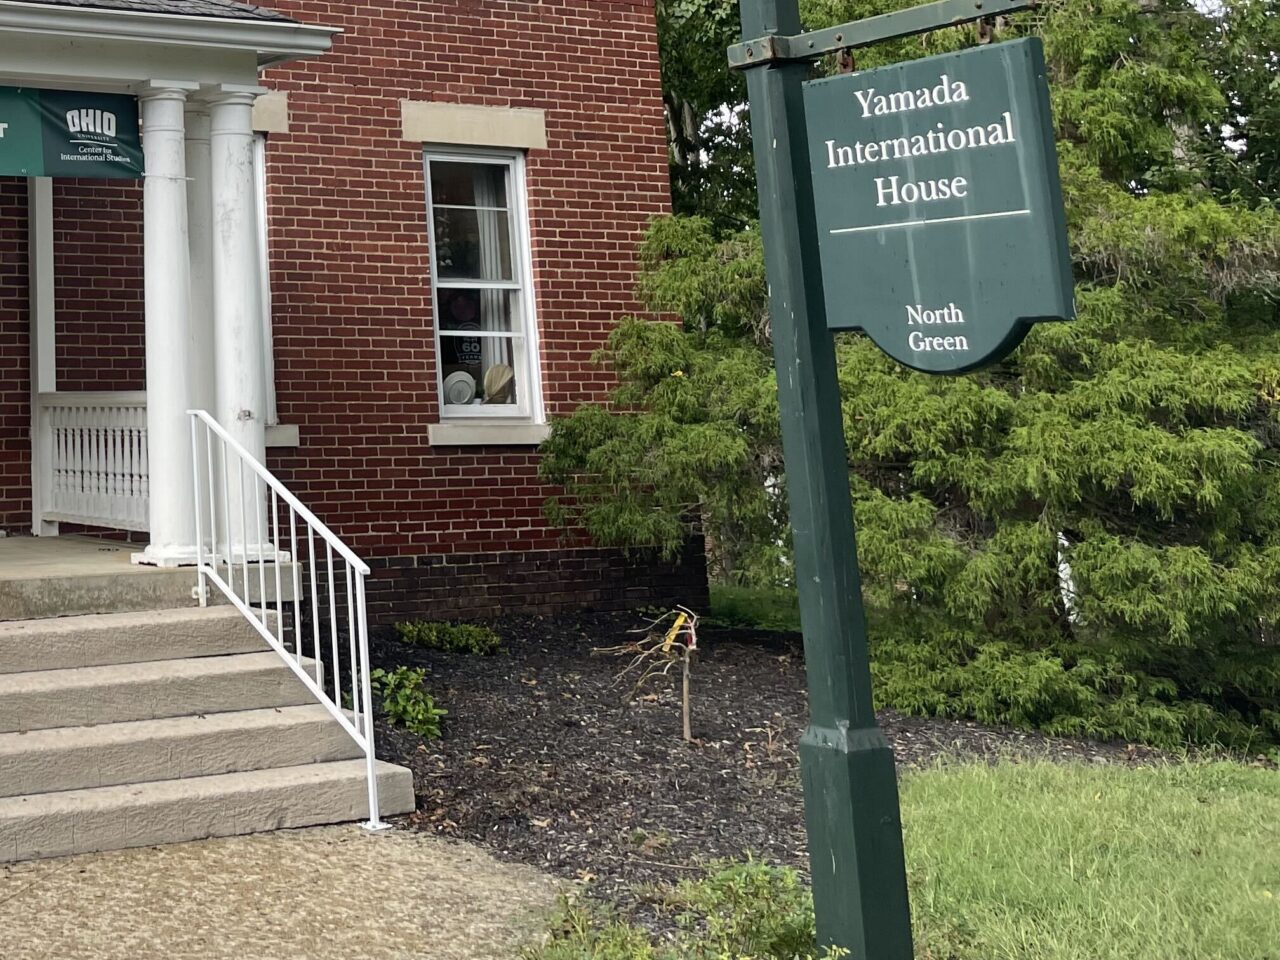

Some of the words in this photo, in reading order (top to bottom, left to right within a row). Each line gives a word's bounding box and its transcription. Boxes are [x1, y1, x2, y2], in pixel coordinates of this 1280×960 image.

[854, 74, 969, 118] Yamada
[66, 108, 116, 137] OHIO
[825, 112, 1016, 168] International
[60, 153, 105, 161] International
[874, 175, 968, 207] House
[905, 302, 965, 325] North
[462, 342, 480, 352] 60
[908, 331, 969, 351] Green
